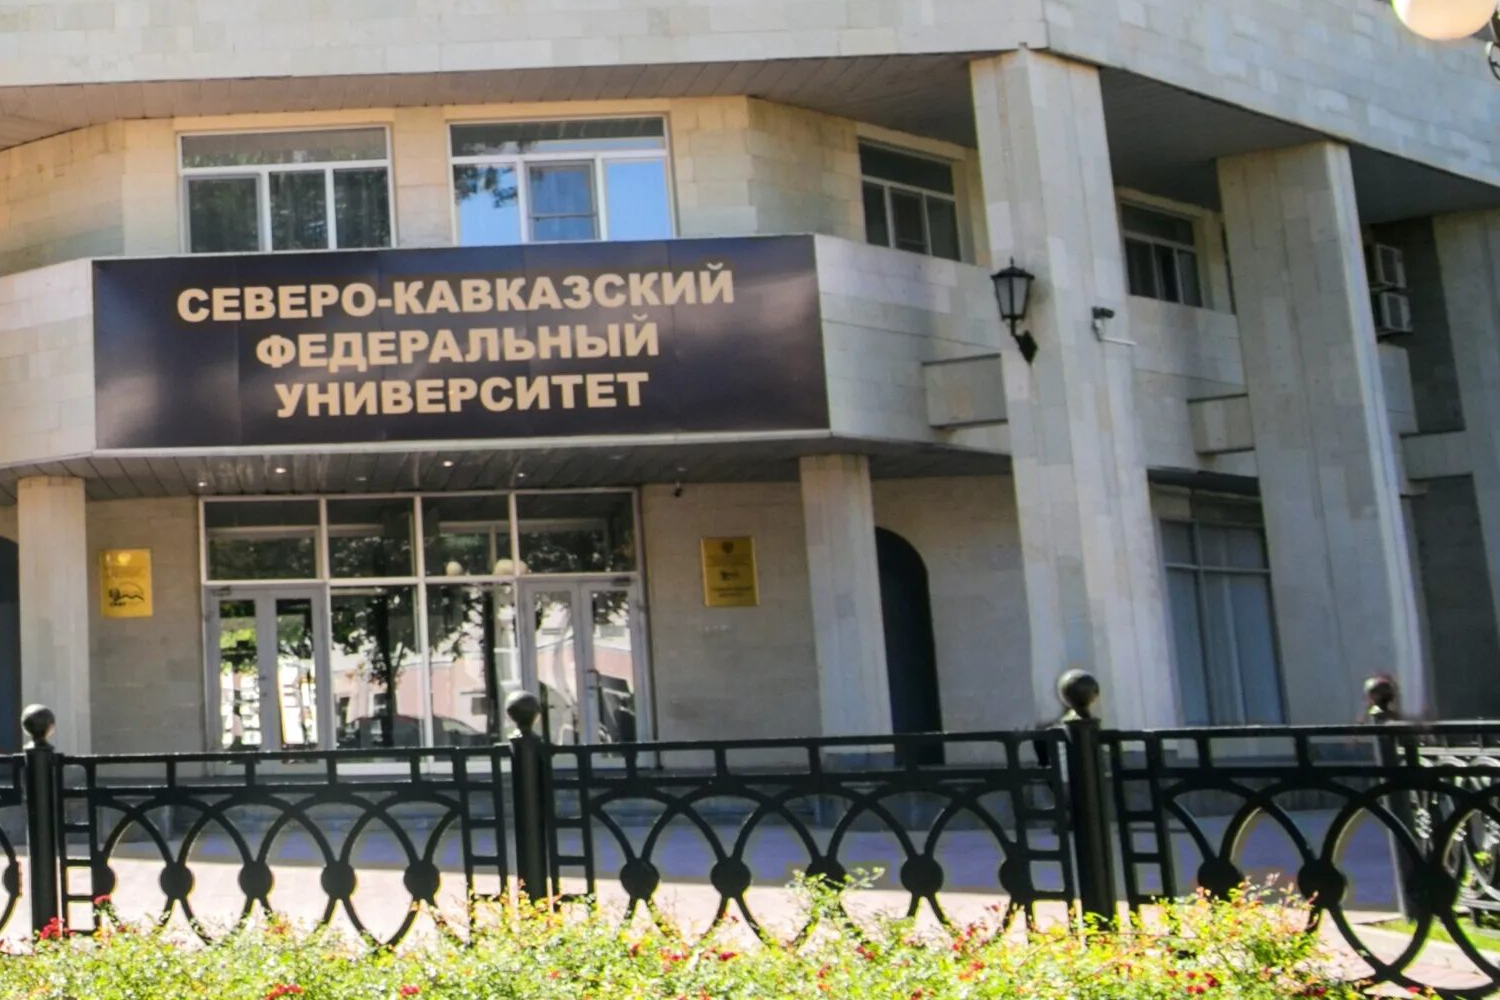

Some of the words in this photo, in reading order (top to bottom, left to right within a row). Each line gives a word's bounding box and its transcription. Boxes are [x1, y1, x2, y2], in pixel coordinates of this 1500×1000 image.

[176, 262, 735, 323] СЕВЕРО-КАВКАЗСКИЙ
[255, 313, 660, 373] ФЕДЕРАЛЬНЫЙ
[274, 371, 650, 418] УНИВЕРСИТЕТ
